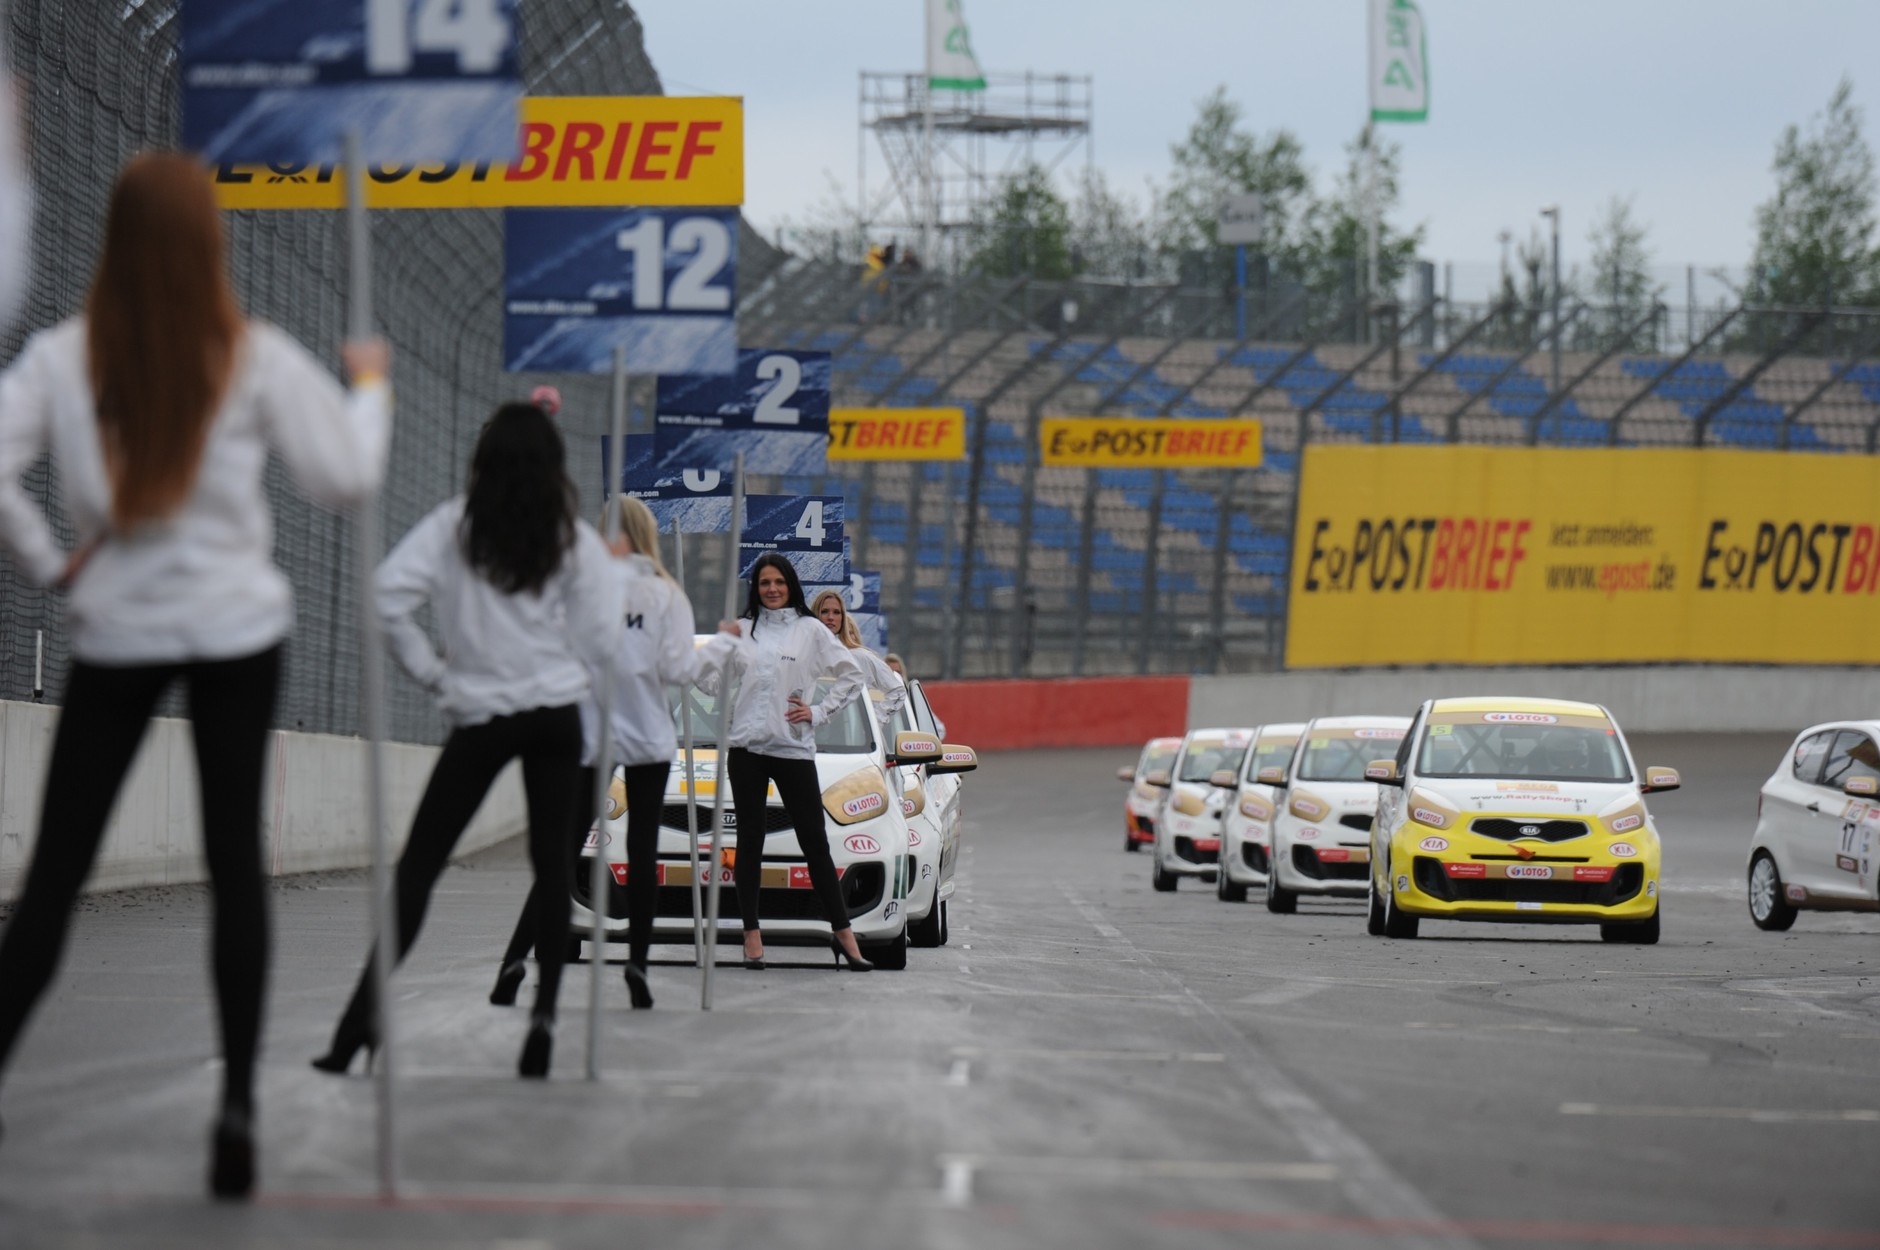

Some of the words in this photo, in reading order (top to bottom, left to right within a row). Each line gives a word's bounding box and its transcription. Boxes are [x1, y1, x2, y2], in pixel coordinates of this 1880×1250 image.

[365, 0, 510, 74] 14
[617, 217, 731, 310] 12
[753, 355, 801, 424] 2
[658, 414, 723, 427] www.dtm.com
[796, 501, 826, 546] 4
[1508, 714, 1549, 722] LOTOS
[857, 796, 880, 810] LOTOS
[1422, 812, 1441, 824] LOTOS
[851, 839, 876, 850] KIA
[1424, 840, 1443, 849] KIA
[1614, 846, 1634, 855] KIA
[1521, 867, 1548, 877] LOTOS
